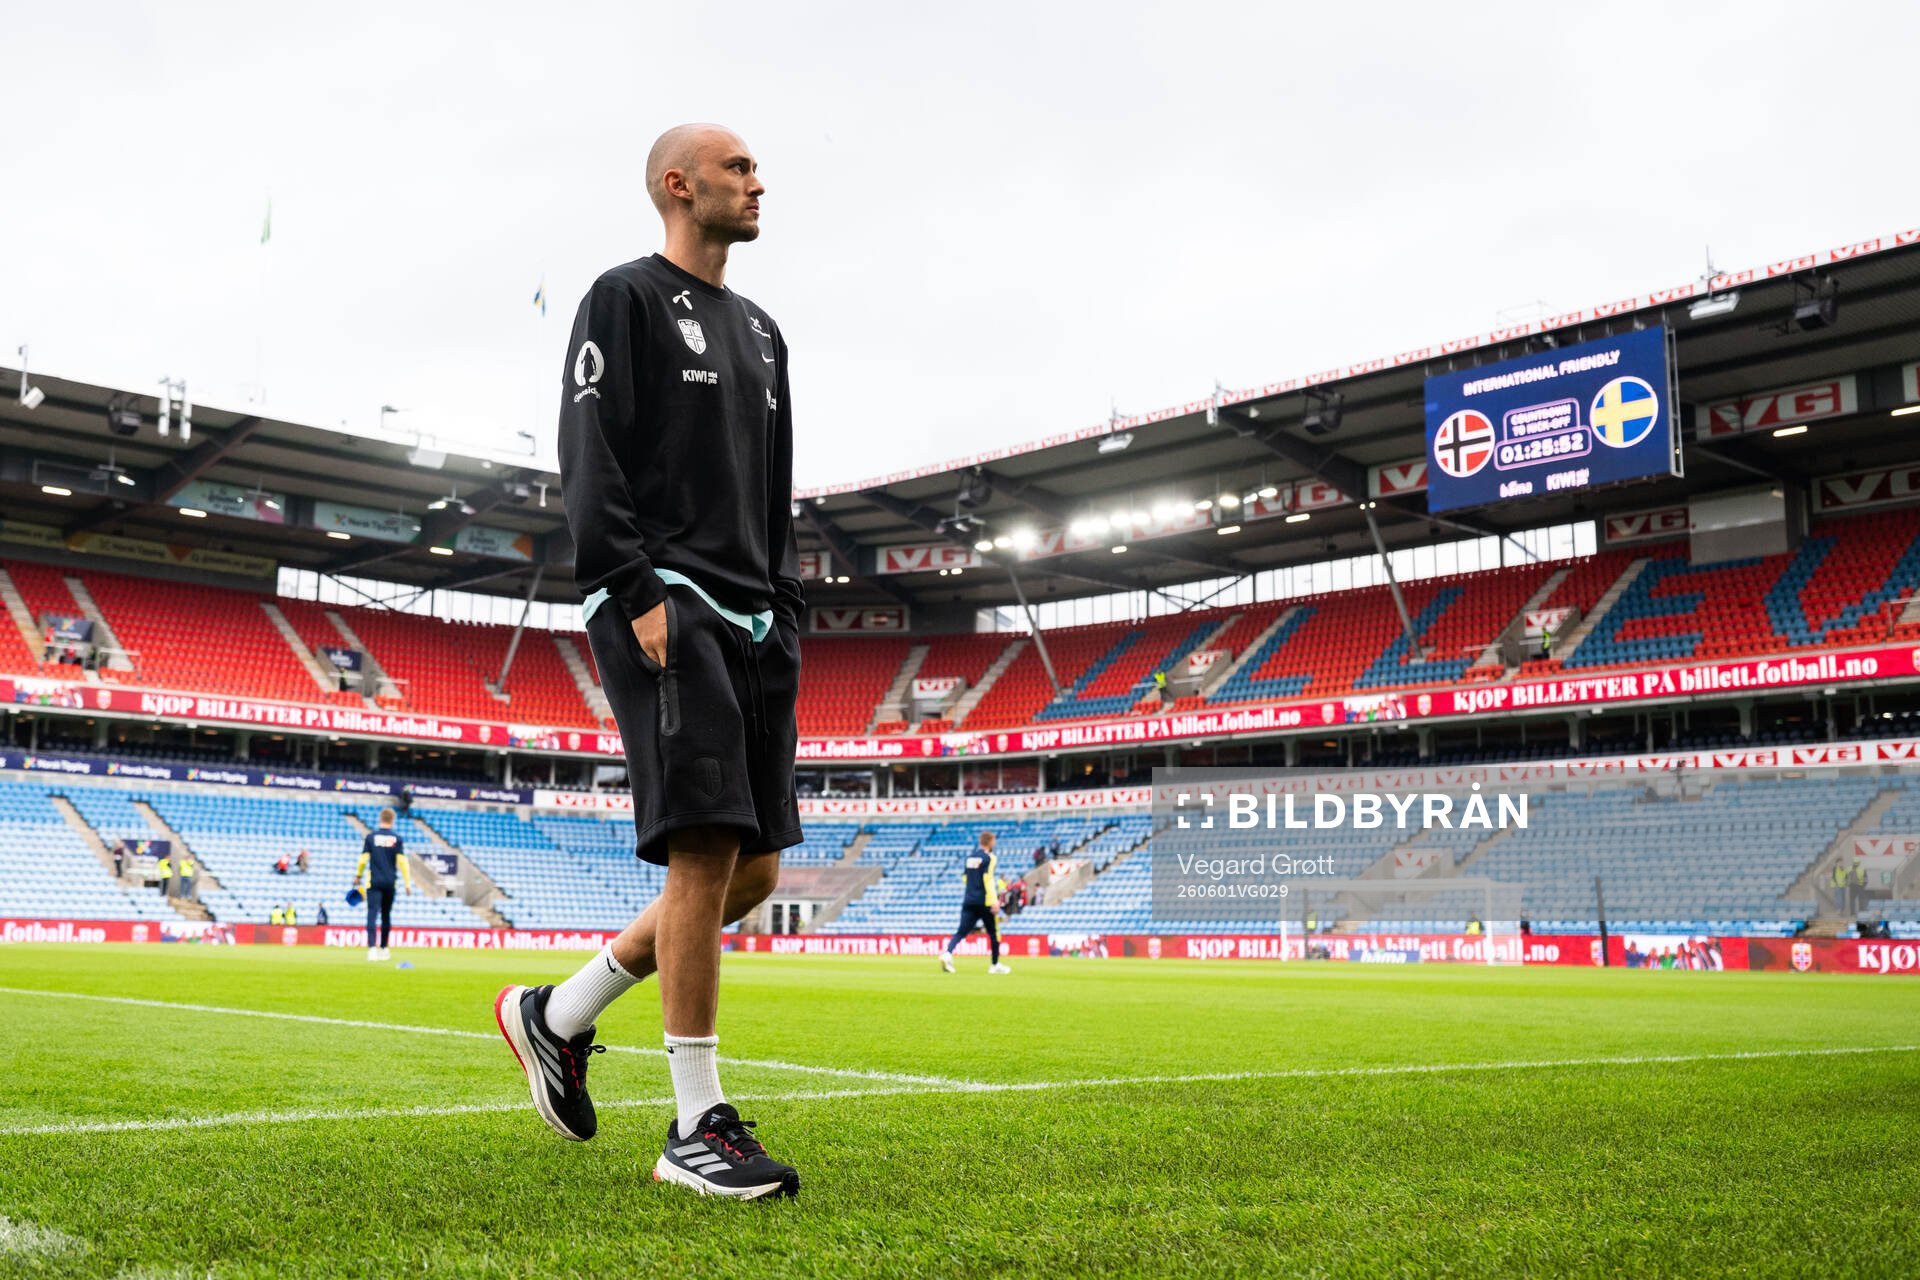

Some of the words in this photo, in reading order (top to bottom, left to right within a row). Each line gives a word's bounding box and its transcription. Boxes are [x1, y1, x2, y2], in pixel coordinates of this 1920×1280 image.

[1594, 298, 1636, 318] VG
[1650, 284, 1693, 304] VG
[1708, 270, 1753, 291] VG
[1768, 255, 1815, 277] VG
[1831, 239, 1880, 262] VG
[682, 369, 707, 383] KIWI
[1463, 364, 1558, 396] INTERNATIONAL
[1560, 350, 1620, 376] FRIENDLY
[1711, 384, 1838, 434] VG
[1380, 462, 1428, 493] V
[1611, 510, 1688, 538] VG
[887, 546, 966, 571] VG
[817, 609, 901, 631] VG
[1453, 687, 1509, 713] KJØP
[1512, 676, 1639, 707] BILLETTER
[1644, 668, 1676, 695] PÅ
[1680, 655, 1878, 692] billett.fotball.no
[197, 698, 303, 726] BILLETTER
[333, 711, 463, 740] billett.fotball.no
[1061, 723, 1146, 745] BILLETTER
[1172, 708, 1301, 736] billett.fotball.no
[824, 800, 868, 813] VG
[877, 800, 918, 813] VG
[928, 799, 967, 812] VG
[976, 797, 1013, 810] VG
[1023, 795, 1059, 808] VG
[1066, 793, 1104, 806] VG
[1111, 790, 1151, 803] VG
[1712, 751, 1778, 768] VG
[1793, 746, 1861, 764] VG
[377, 930, 476, 949] ILLETTER
[1857, 944, 1920, 974] KJØ
